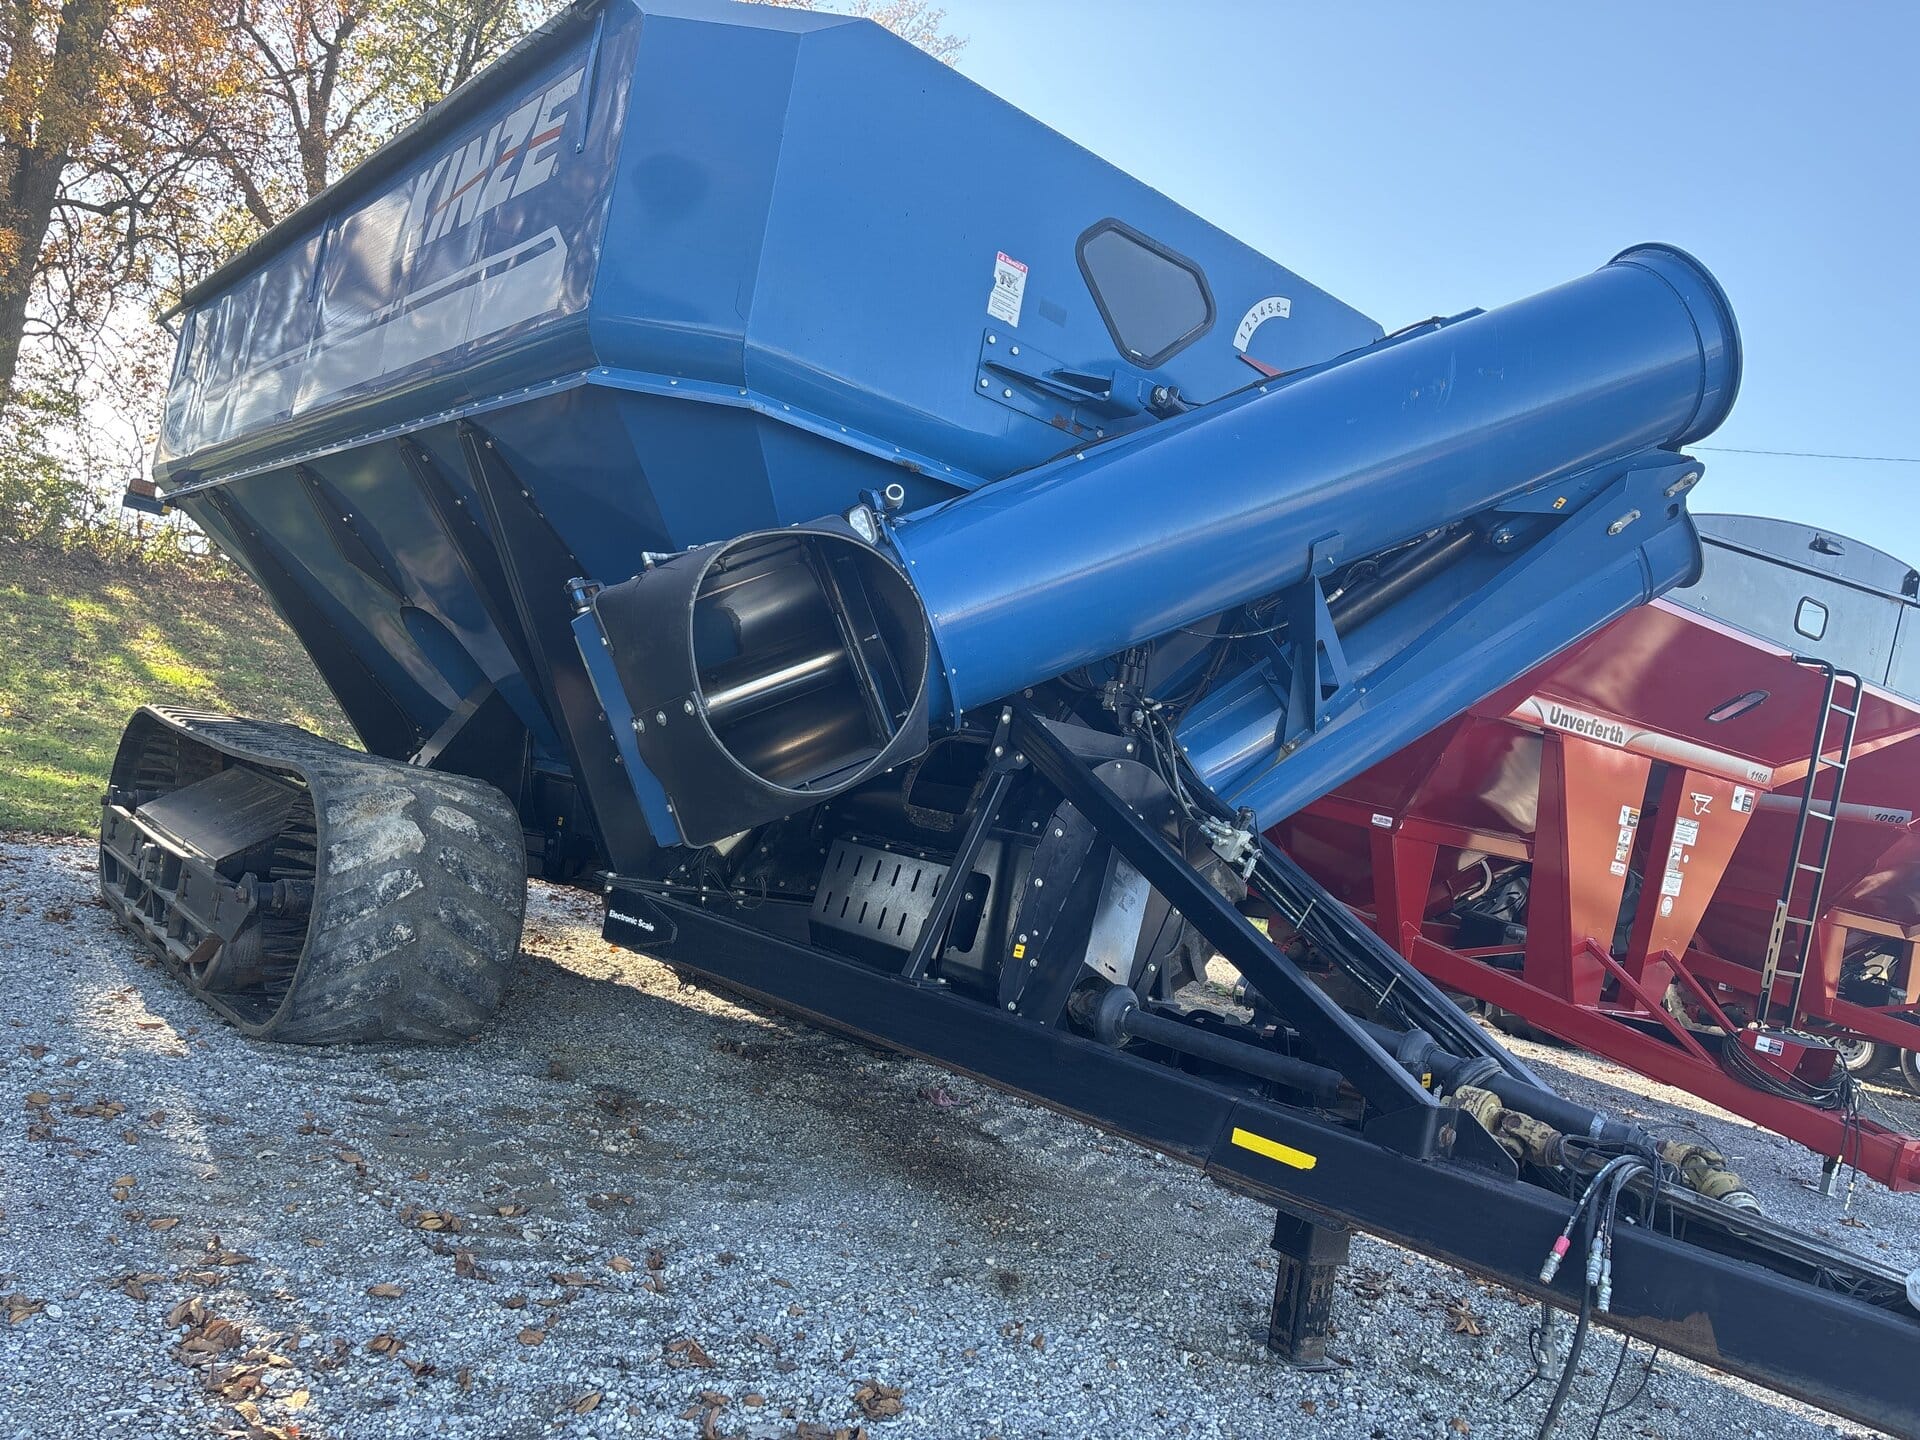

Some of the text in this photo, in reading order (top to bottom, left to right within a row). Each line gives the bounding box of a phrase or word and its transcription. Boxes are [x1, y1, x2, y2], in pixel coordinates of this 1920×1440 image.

[404, 67, 585, 250] KINZE
[1245, 321, 1252, 332] 2
[1252, 312, 1259, 323] 3
[1260, 306, 1265, 316] 4
[1268, 302, 1273, 313] 5
[1276, 301, 1281, 313] 6
[1549, 705, 1624, 744] Unverferth
[1750, 770, 1768, 784] 1160
[1873, 812, 1905, 824] 1060
[609, 909, 654, 931] Electronic Scale
